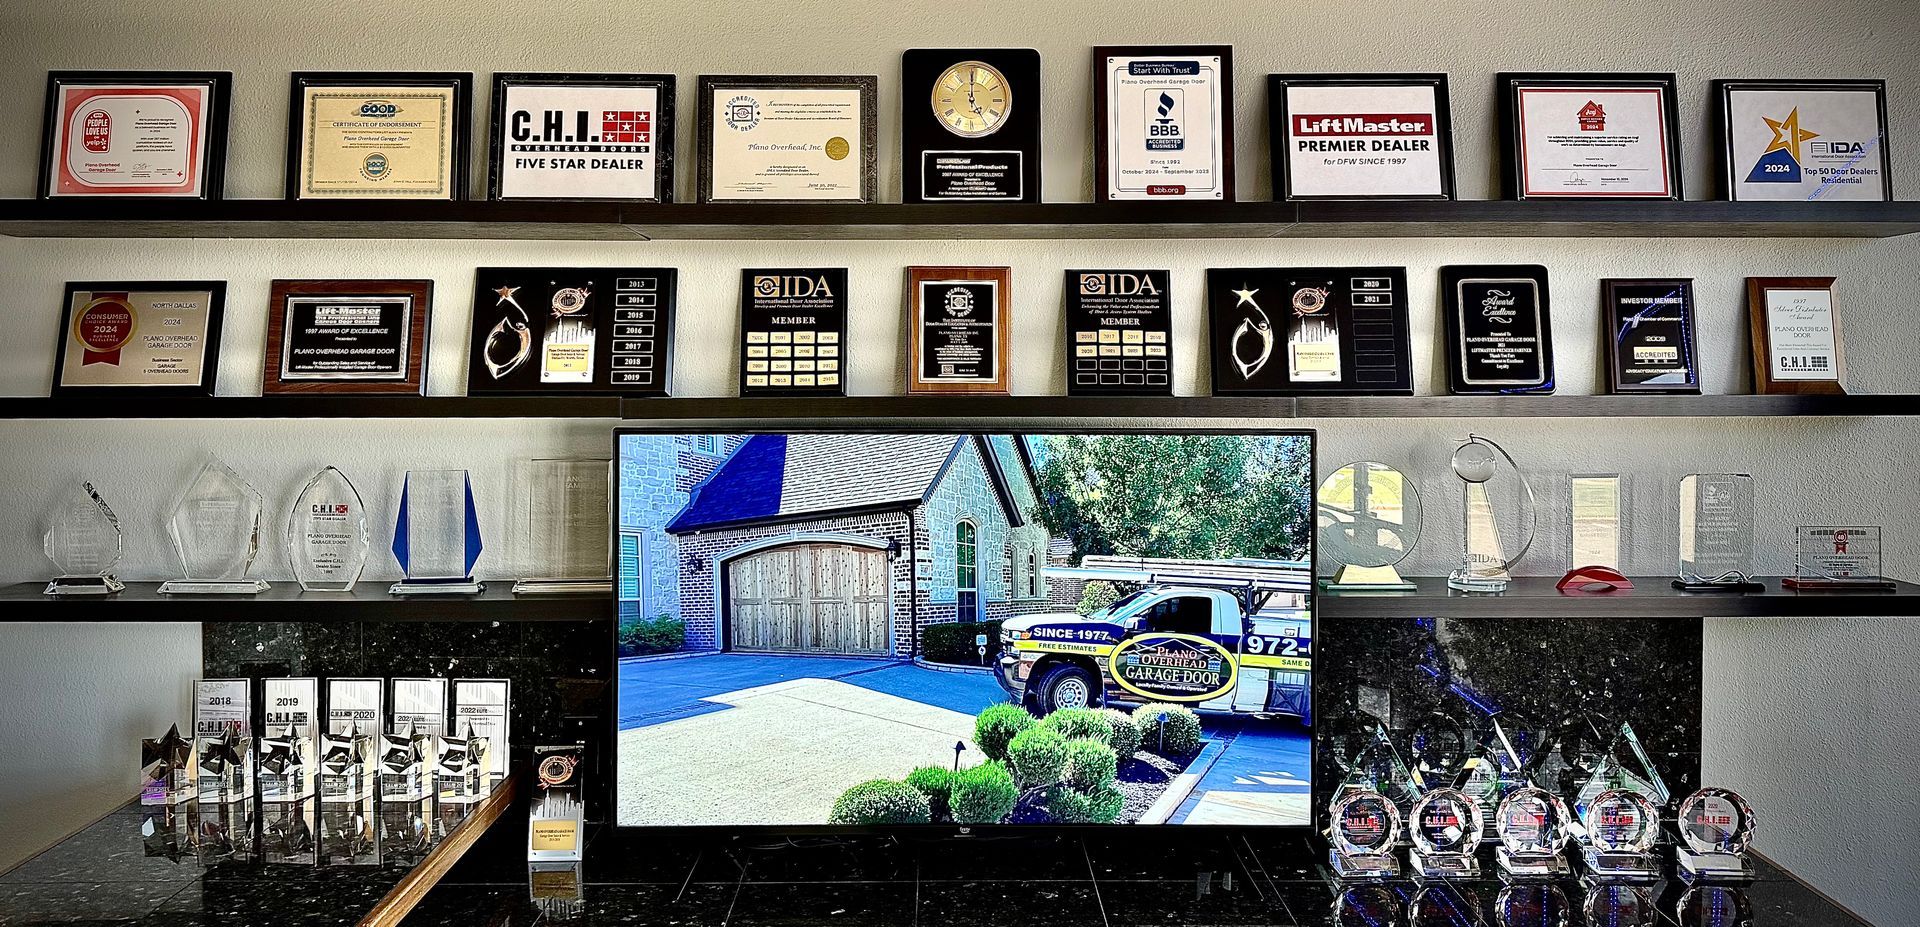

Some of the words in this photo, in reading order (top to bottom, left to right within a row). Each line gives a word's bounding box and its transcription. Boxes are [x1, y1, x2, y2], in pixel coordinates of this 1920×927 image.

[726, 96, 759, 109] ACCREDITED
[361, 104, 396, 113] GOOD
[88, 119, 108, 127] PEOPLE
[512, 111, 599, 142] C.H.I.
[726, 118, 738, 130] DOOR
[741, 118, 760, 131] DEALER
[86, 127, 99, 135] LOVE
[1299, 141, 1367, 151] PREMIER
[1372, 140, 1430, 151] DEALER
[1831, 142, 1864, 153] IDA
[516, 159, 545, 168] FIVE
[551, 159, 585, 169] STAR
[592, 159, 643, 169] DEALER
[1765, 164, 1790, 172] 2024
[1821, 176, 1862, 184] Residential
[782, 275, 833, 297] IDA
[1108, 274, 1159, 295] IDA
[1482, 296, 1515, 305] Award
[1483, 306, 1516, 316] Excellence
[1781, 356, 1811, 367] C.H.I.
[312, 505, 335, 513] C.H.I.
[1034, 628, 1073, 638] SINCE
[1077, 630, 1109, 640] 1977
[1058, 644, 1096, 652] ESTIMATES
[1247, 637, 1311, 656] 972-
[1157, 646, 1198, 659] PLANO
[1142, 655, 1206, 669] OVERHEAD
[1126, 667, 1180, 682] GARAGE
[1183, 671, 1220, 685] DOOR
[209, 697, 231, 705] 2018
[277, 698, 298, 706] 2019
